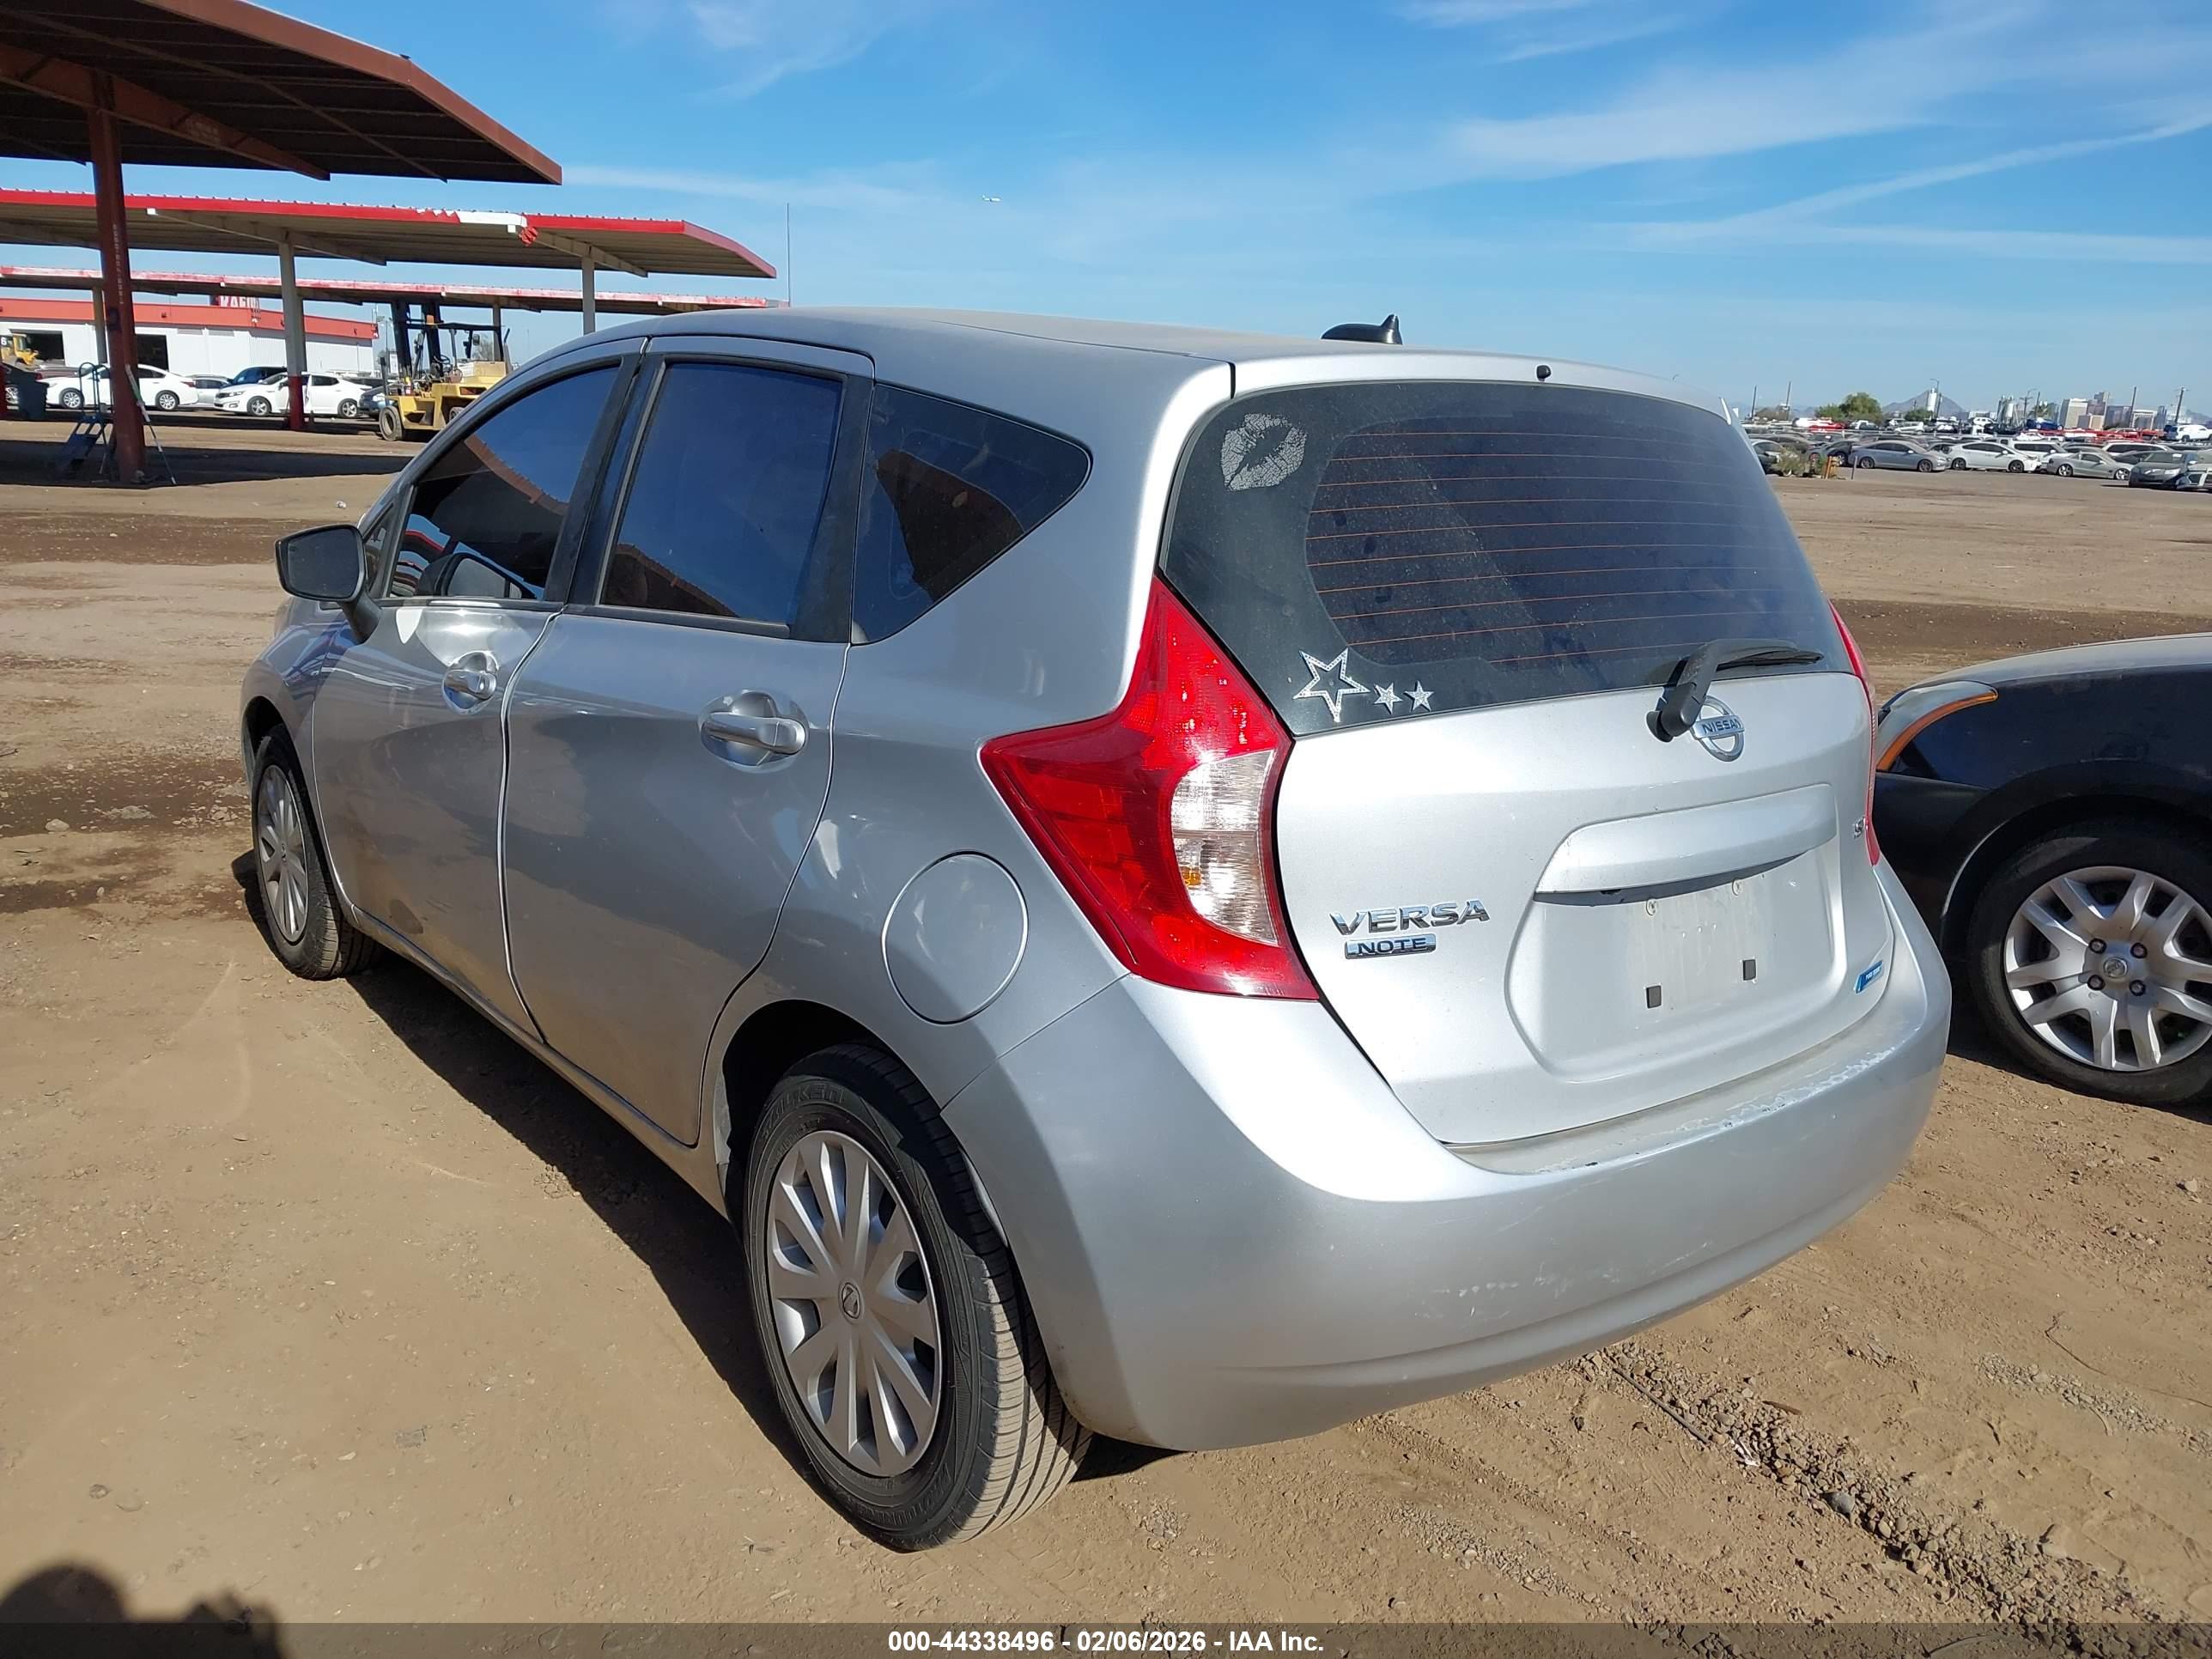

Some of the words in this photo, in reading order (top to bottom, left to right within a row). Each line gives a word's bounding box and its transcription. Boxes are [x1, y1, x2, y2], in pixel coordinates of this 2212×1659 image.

[1702, 718, 1741, 734] NISSAN
[1329, 899, 1491, 936] VERSA
[1357, 937, 1428, 955] NOTE
